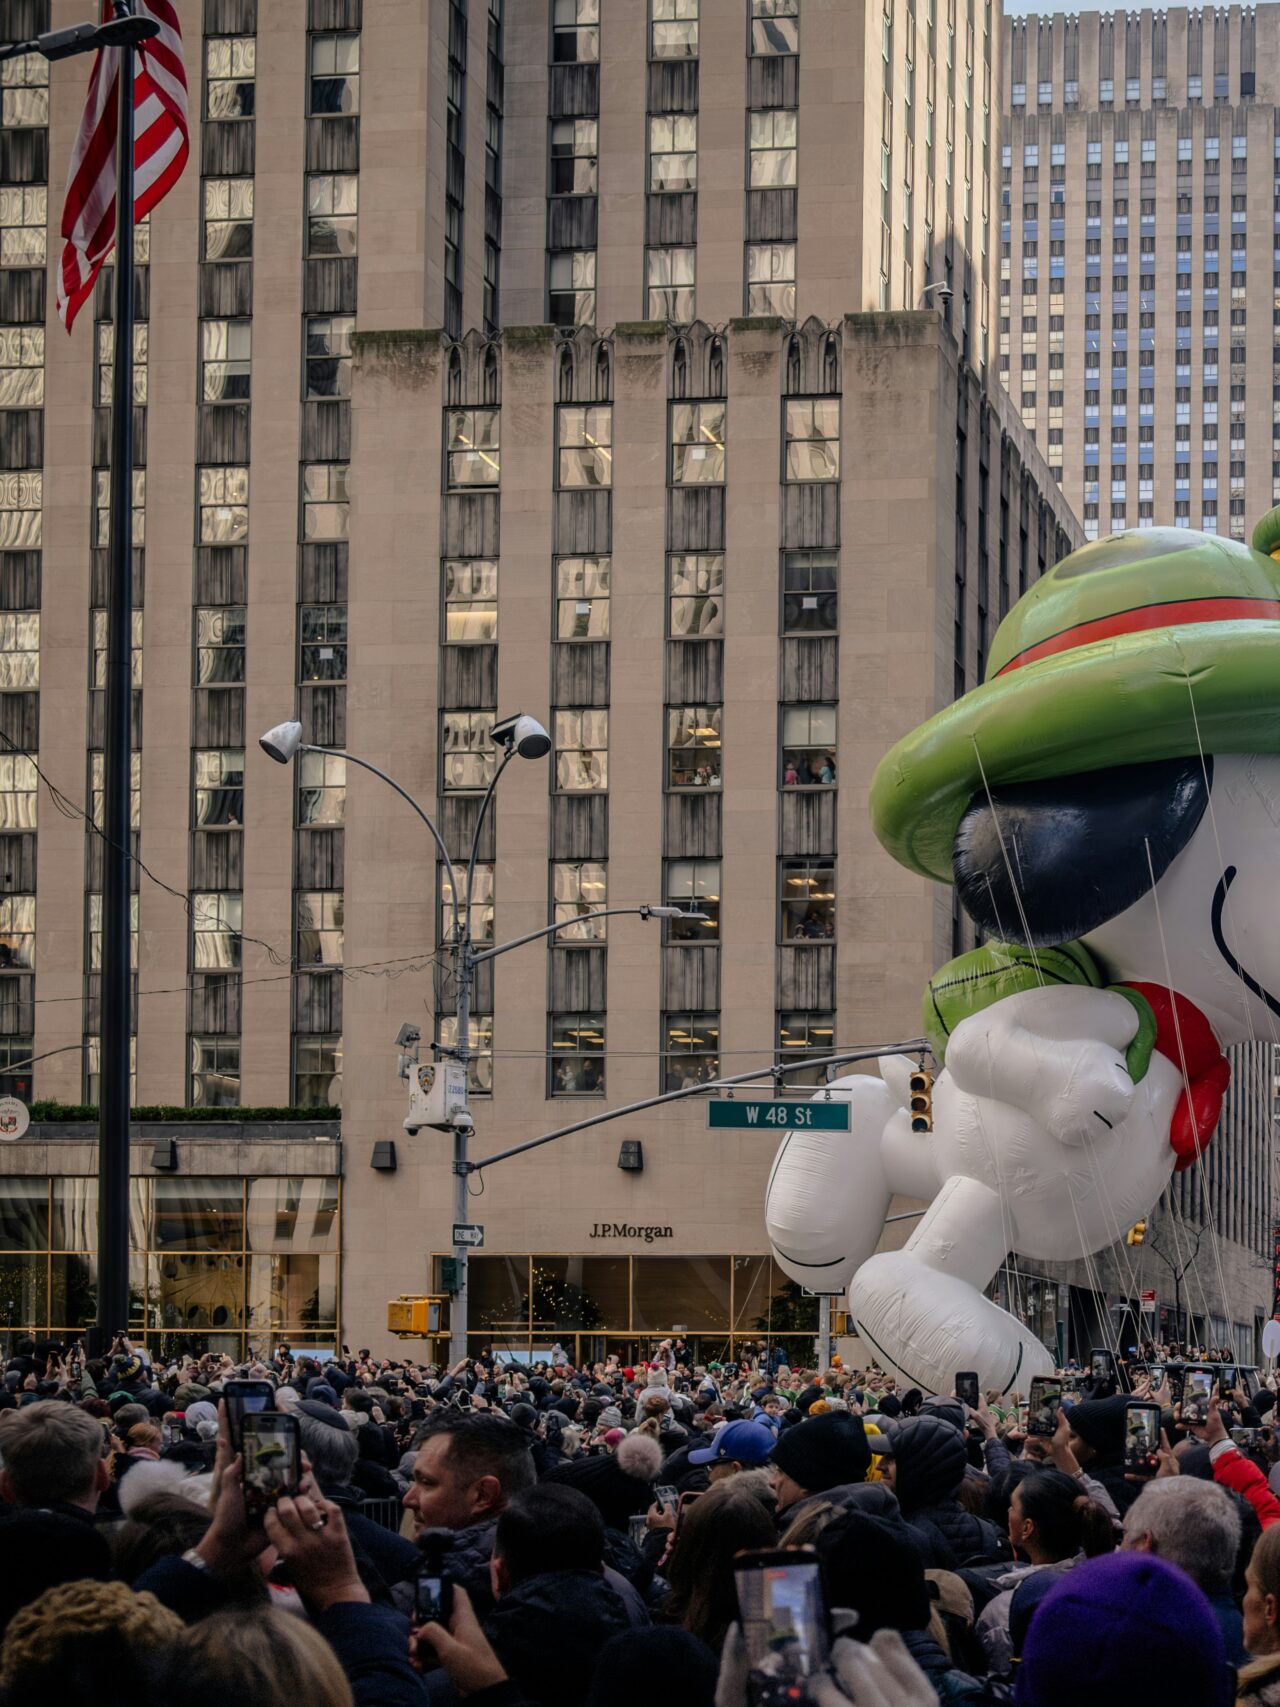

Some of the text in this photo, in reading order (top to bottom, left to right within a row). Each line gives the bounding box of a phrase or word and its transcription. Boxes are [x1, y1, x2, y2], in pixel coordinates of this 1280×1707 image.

[746, 1106, 812, 1125] W 48 St
[589, 1223, 674, 1243] J.P.Morgan
